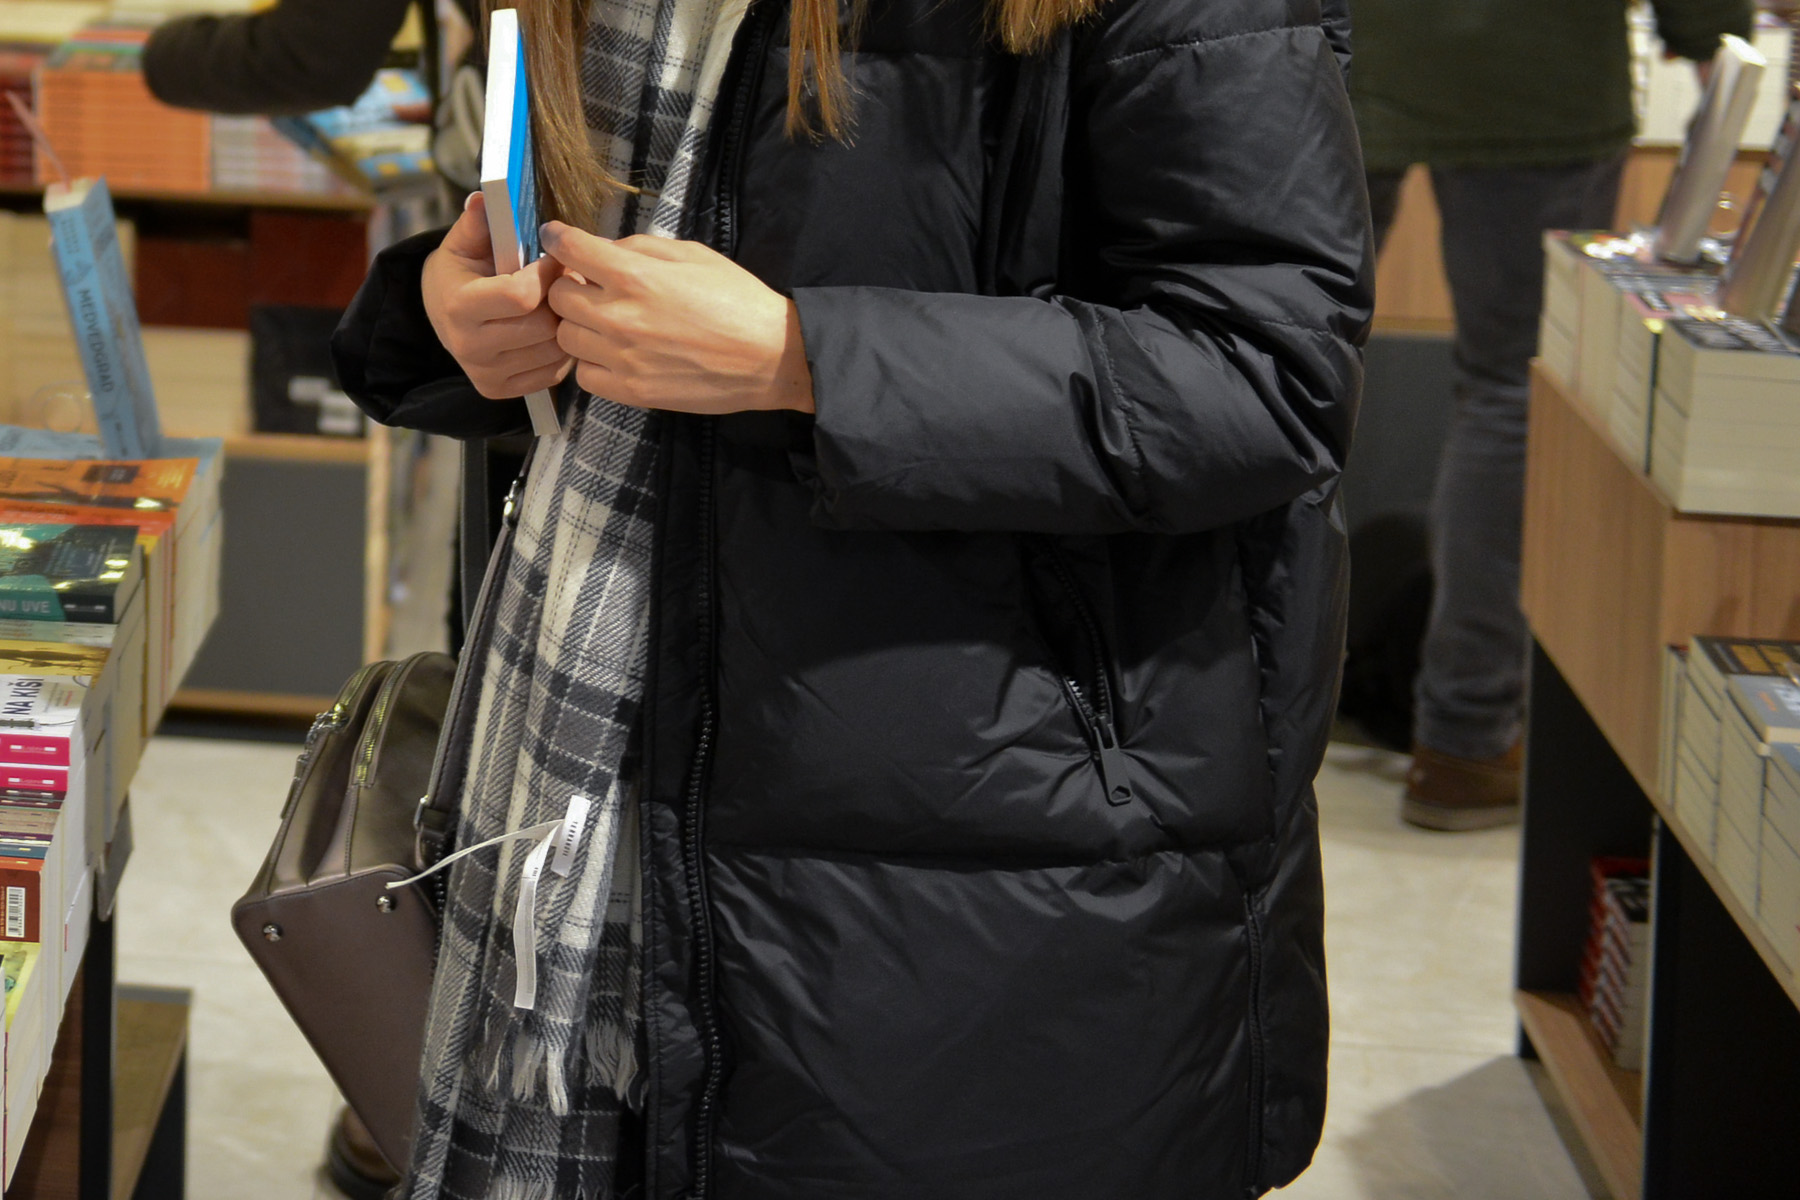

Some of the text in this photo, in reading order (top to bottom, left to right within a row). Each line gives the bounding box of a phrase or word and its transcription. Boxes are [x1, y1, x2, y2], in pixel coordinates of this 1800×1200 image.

[77, 288, 116, 394] MEDVEDGRAD
[22, 600, 51, 614] UVE
[2, 676, 45, 716] NA KIŠI
